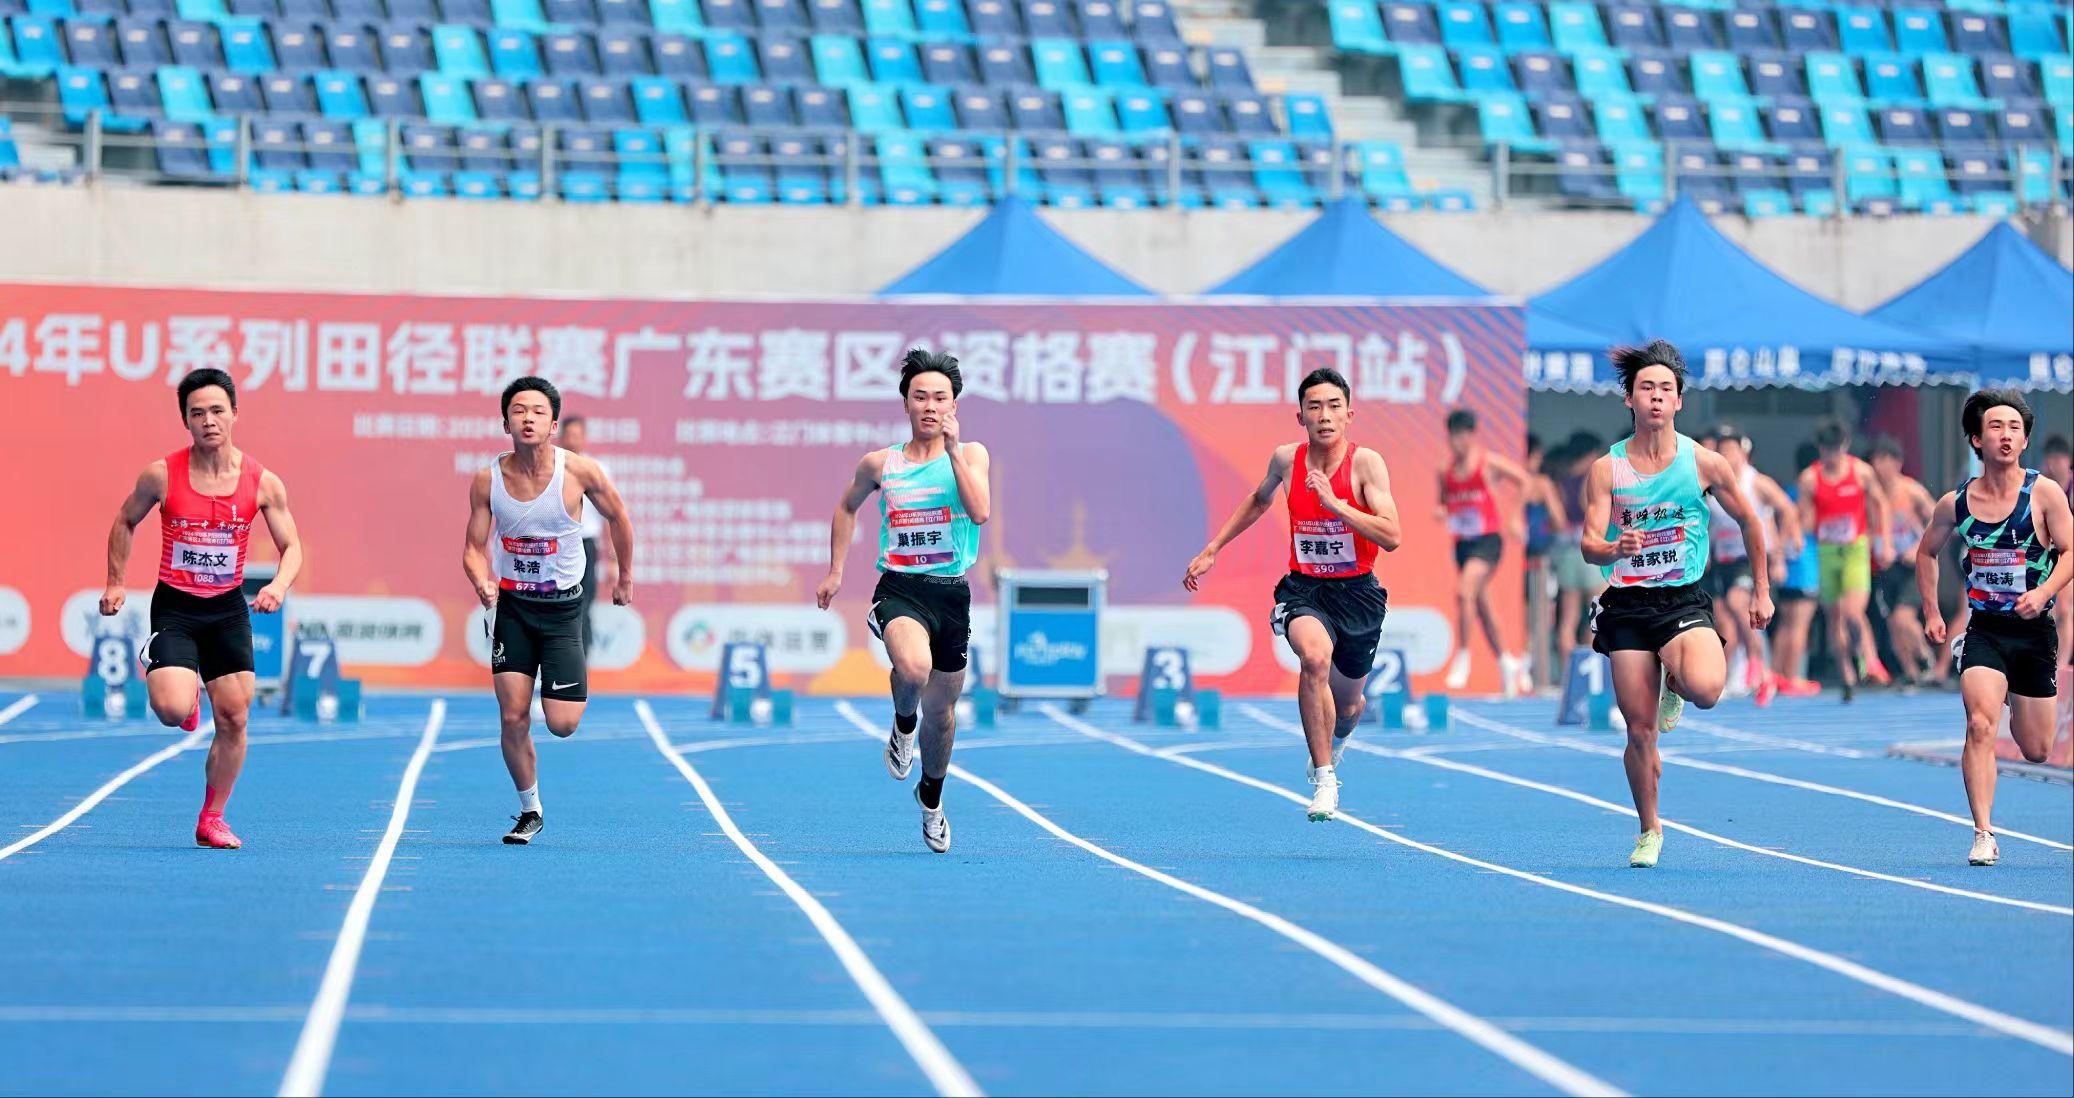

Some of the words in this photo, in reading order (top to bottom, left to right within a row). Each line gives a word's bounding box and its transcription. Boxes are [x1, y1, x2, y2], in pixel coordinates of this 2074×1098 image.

[897, 531, 942, 547] 巢振宇
[1300, 540, 1343, 555] 李嘉宁
[182, 549, 228, 567] 陈杰文
[513, 558, 540, 574] 梁浩
[916, 556, 927, 564] 10
[1631, 549, 1678, 568] 骆家锐
[194, 573, 214, 582] 1088
[1314, 564, 1334, 573] 390
[515, 582, 537, 591] 673
[98, 638, 129, 686] 8
[300, 642, 331, 679] 7
[729, 645, 762, 689] 5
[1152, 650, 1187, 690] 3
[1367, 651, 1403, 696] 2
[1578, 655, 1605, 695] 1
